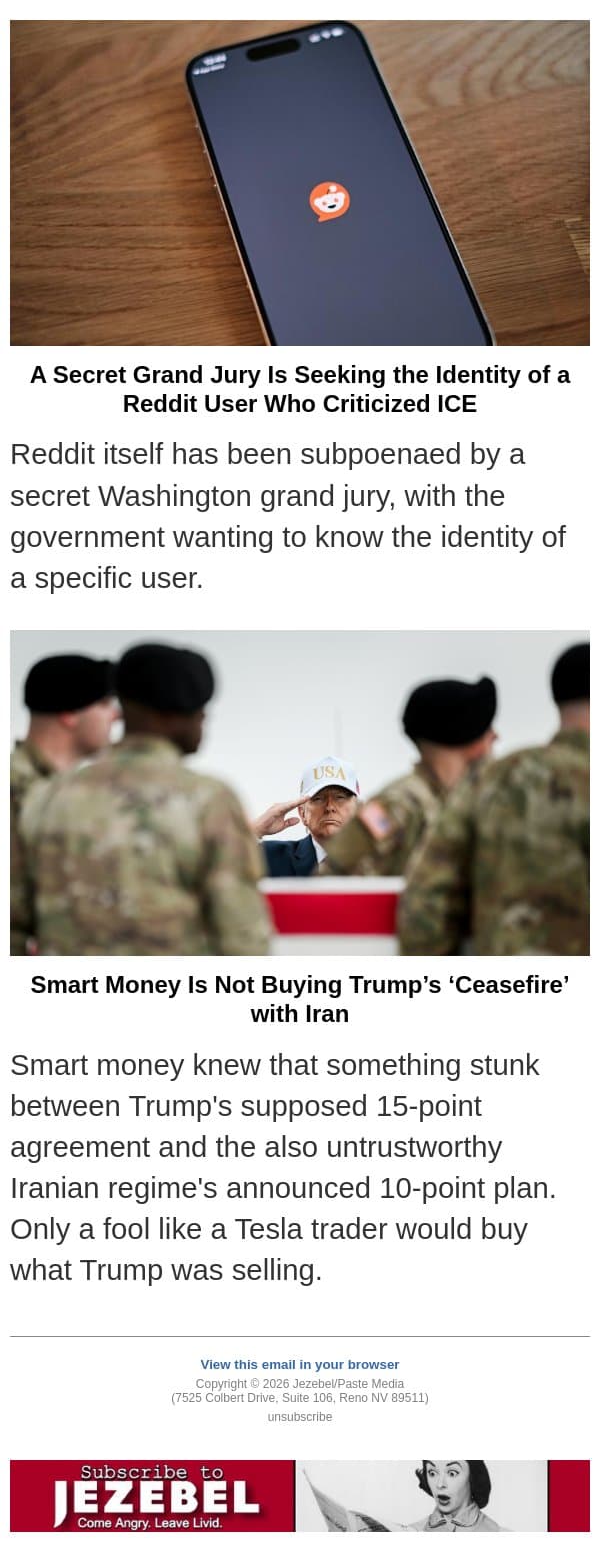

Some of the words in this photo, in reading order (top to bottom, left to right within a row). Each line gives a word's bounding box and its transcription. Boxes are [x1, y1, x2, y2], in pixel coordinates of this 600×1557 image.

[124, 394, 198, 412] Reddit
[205, 395, 258, 412] User
[264, 394, 316, 412] Who
[324, 394, 430, 412] Criticized
[439, 395, 477, 412] ICE
[313, 765, 346, 780] USA
[250, 1004, 298, 1022] with
[306, 1005, 348, 1022] Iran
[10, 1258, 72, 1280] what
[80, 1260, 162, 1286] Trump
[172, 1264, 222, 1280] was
[233, 1258, 320, 1286] selling.
[201, 1359, 230, 1370] View
[235, 1359, 258, 1370] this
[262, 1359, 296, 1370] email
[300, 1359, 311, 1370] in
[315, 1361, 344, 1373] your
[349, 1359, 400, 1370] browser
[195, 1378, 247, 1391] Copyright
[263, 1379, 290, 1389] 2026
[293, 1378, 368, 1389] Jezebel/Paste
[372, 1378, 404, 1389] Media
[171, 1392, 202, 1405] (7525
[205, 1392, 244, 1403] Colbert
[248, 1392, 279, 1405] Drive,
[282, 1392, 309, 1403] Suite
[313, 1393, 335, 1405] 106,
[340, 1393, 368, 1403] Reno
[371, 1393, 388, 1403] NV
[391, 1392, 429, 1405] 89511)
[268, 1411, 332, 1422] unsubscribe
[81, 1465, 188, 1479] Subscribe
[200, 1465, 223, 1479] to
[53, 1480, 260, 1529] JEZEBEL
[77, 1517, 112, 1529] Come
[115, 1517, 151, 1531] Angry.
[155, 1517, 190, 1529] Leave
[193, 1517, 223, 1529] Livid.
